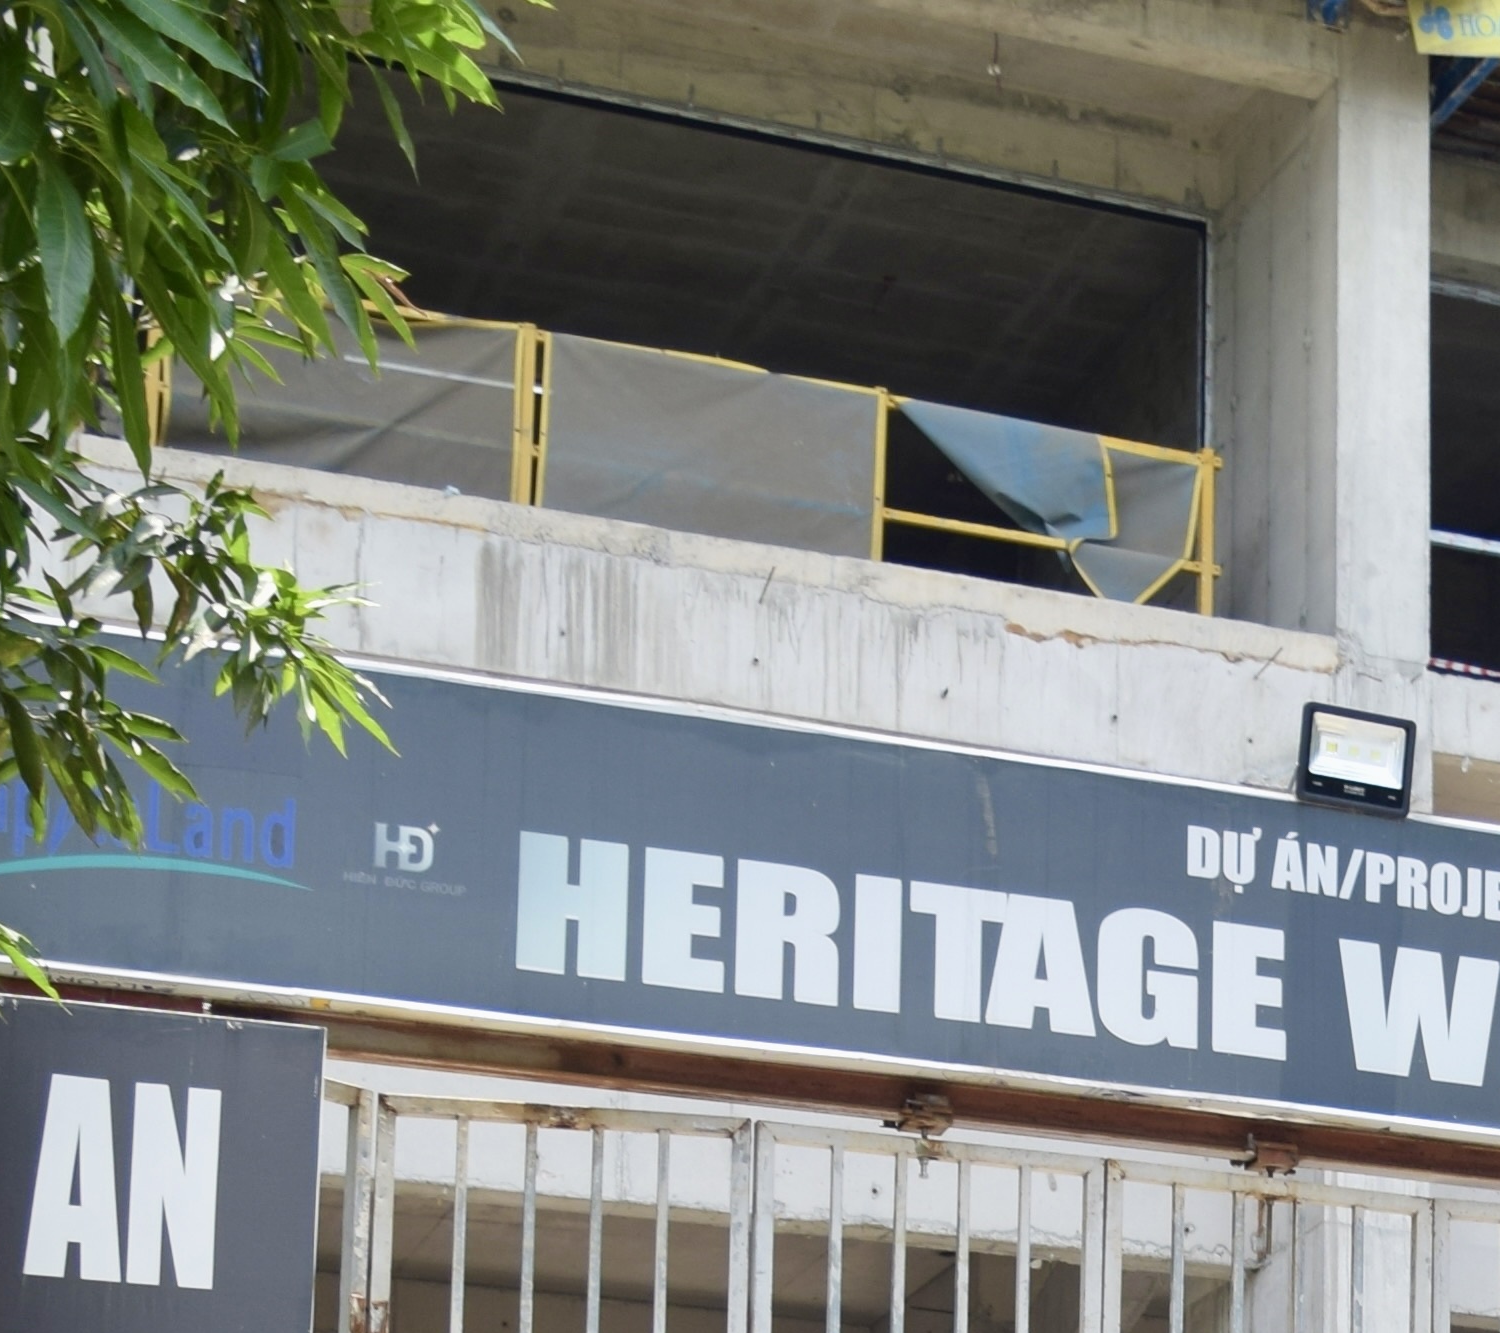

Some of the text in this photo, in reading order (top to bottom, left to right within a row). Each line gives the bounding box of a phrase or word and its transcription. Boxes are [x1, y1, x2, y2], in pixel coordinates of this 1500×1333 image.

[516, 830, 1288, 1062] HERITAGE
[1186, 824, 1263, 894] DỰ
[22, 1073, 223, 1290] AN
